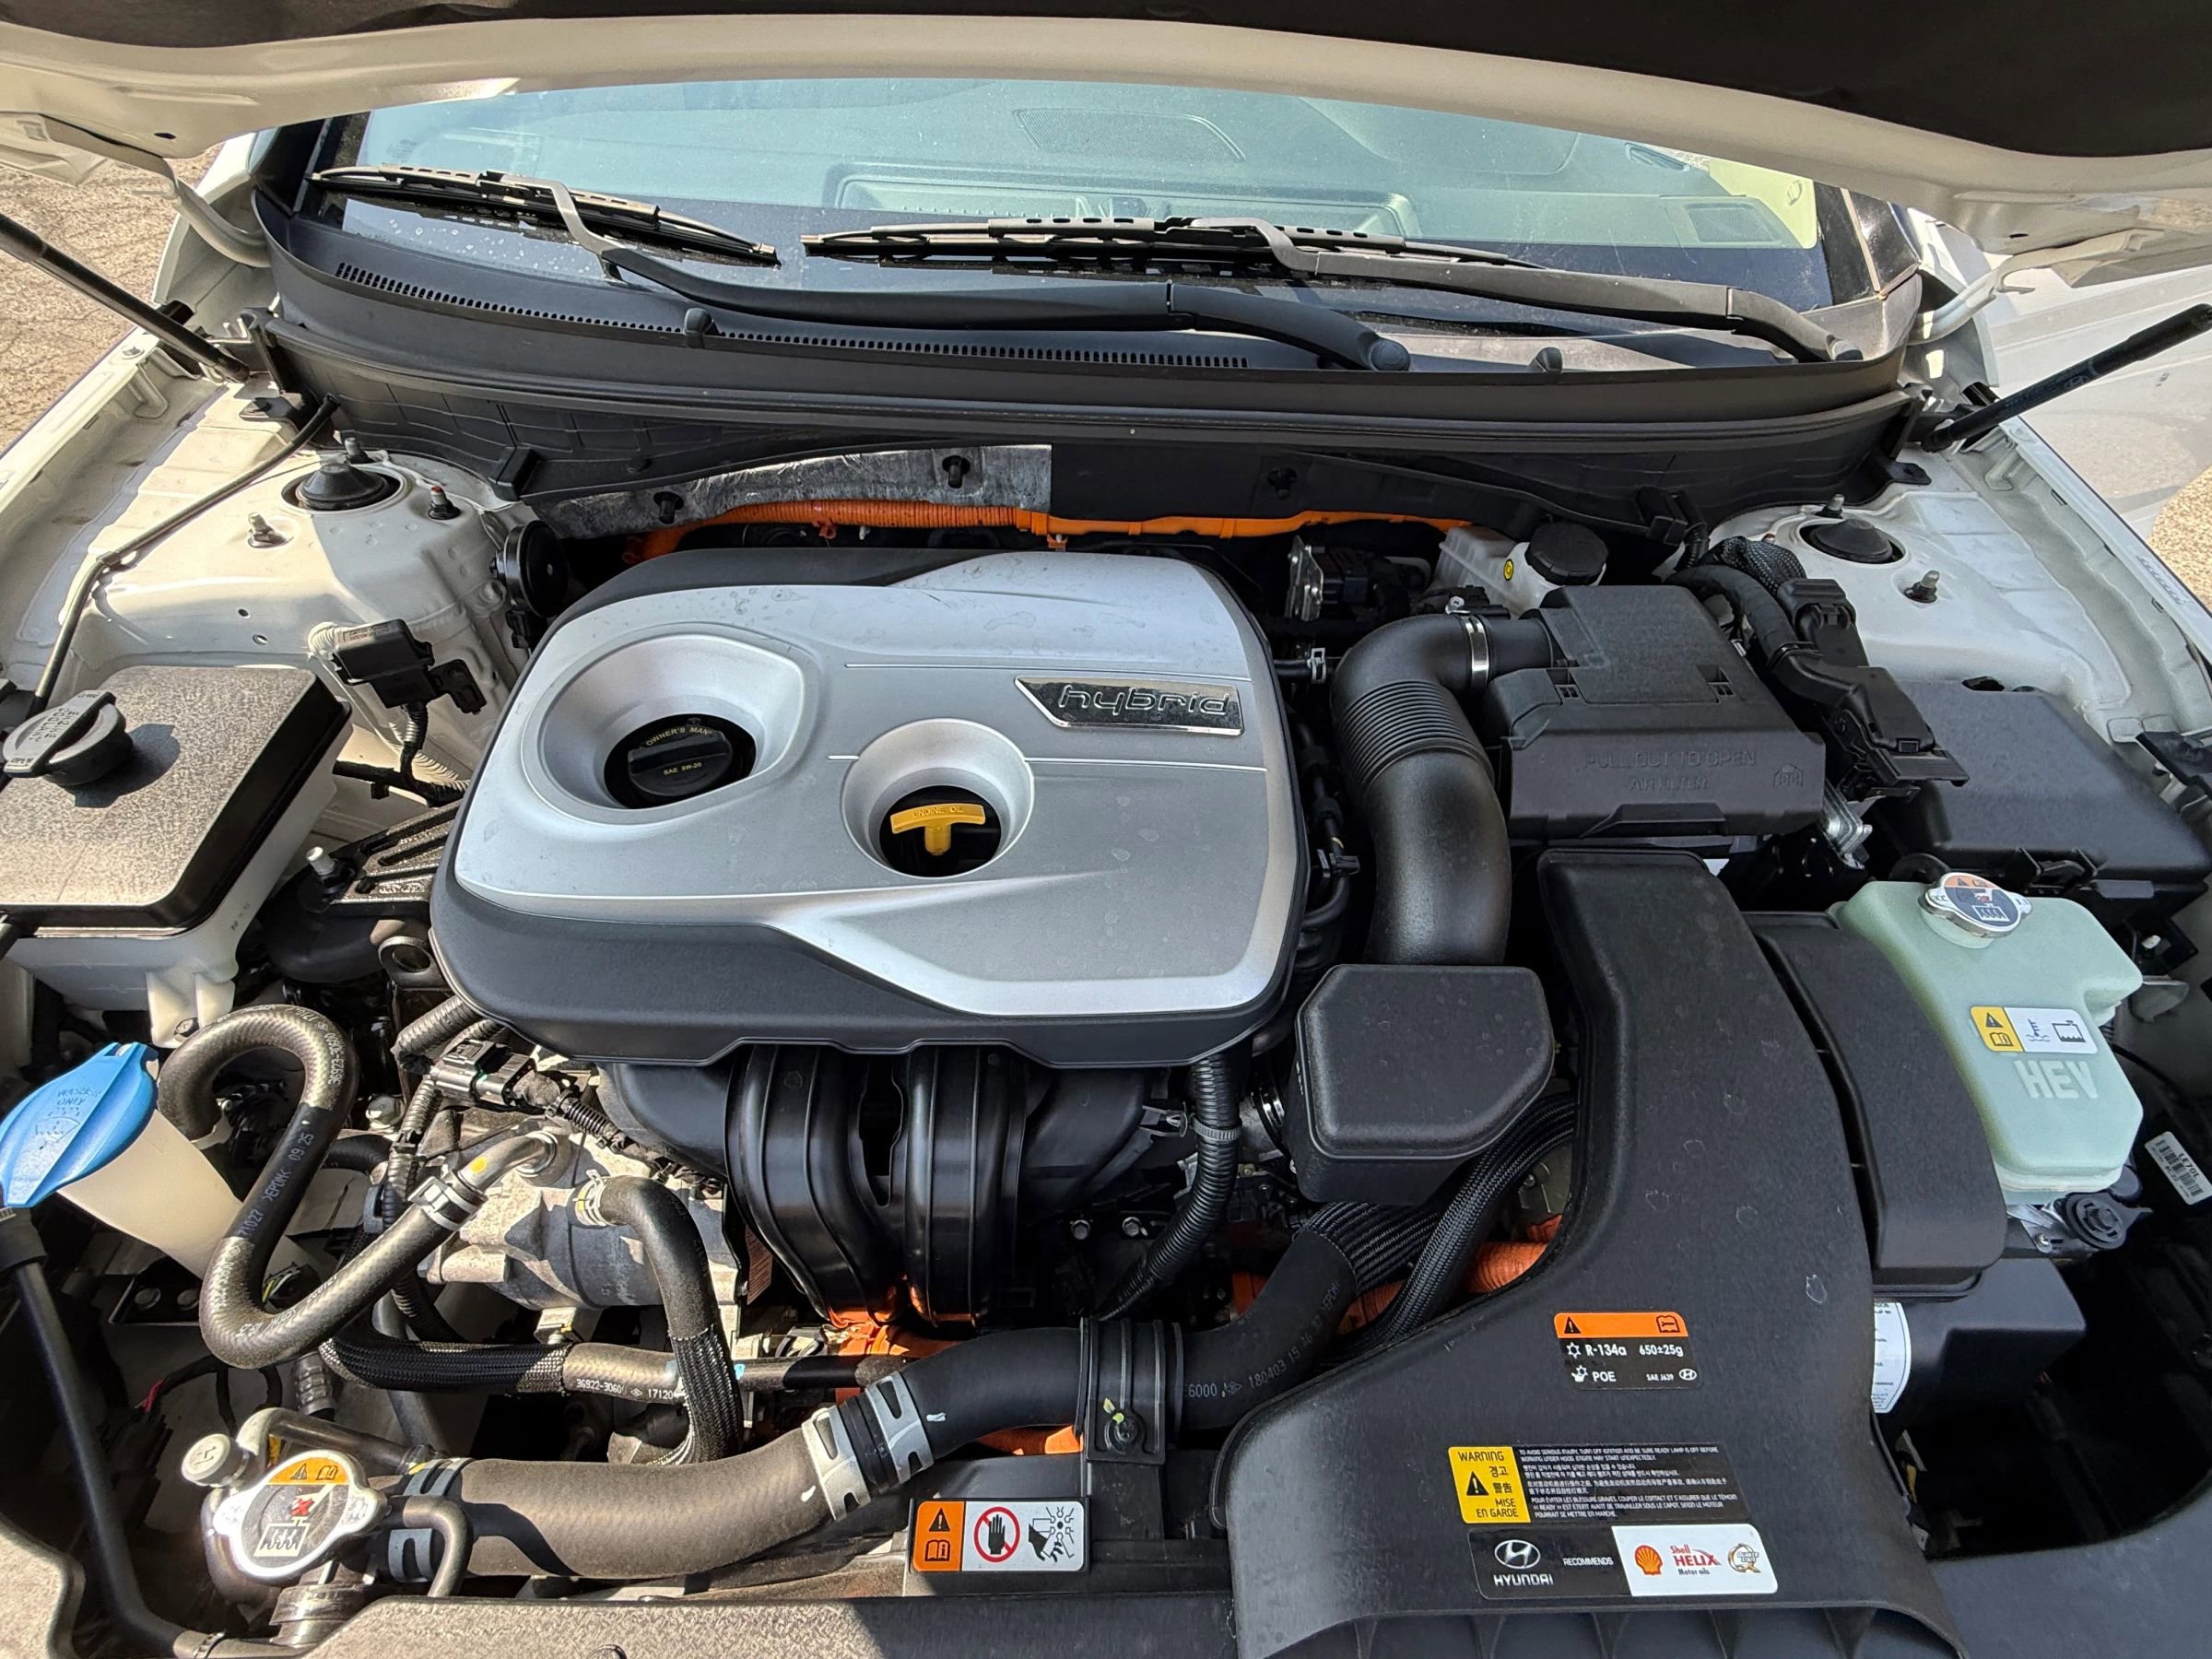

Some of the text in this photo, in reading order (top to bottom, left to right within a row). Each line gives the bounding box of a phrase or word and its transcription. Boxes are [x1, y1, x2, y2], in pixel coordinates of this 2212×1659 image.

[1058, 684, 1231, 716] hybrid
[646, 727, 687, 746] OWNER'S
[1584, 751, 1757, 769] PULL OUT TO OPEN
[664, 767, 678, 775] SAE
[912, 806, 945, 818] ENGINE
[2013, 1060, 2099, 1099] HEV
[1585, 1344, 1684, 1358] R-134a 650±25g
[1248, 1359, 1287, 1388] 180403
[1592, 1371, 1674, 1382] POE SAE J639
[1458, 1452, 1505, 1462] WARNING
[1488, 1465, 1509, 1478] 경고
[1492, 1482, 1512, 1494] 警告
[1495, 1499, 1517, 1508] MISE
[1476, 1508, 1519, 1518] EN GARDE
[1670, 1546, 1690, 1555] Shell
[1562, 1557, 1614, 1566] RECOMMENDS
[1675, 1554, 1719, 1567] HELIX
[1493, 1573, 1554, 1586] HYUNDAI
